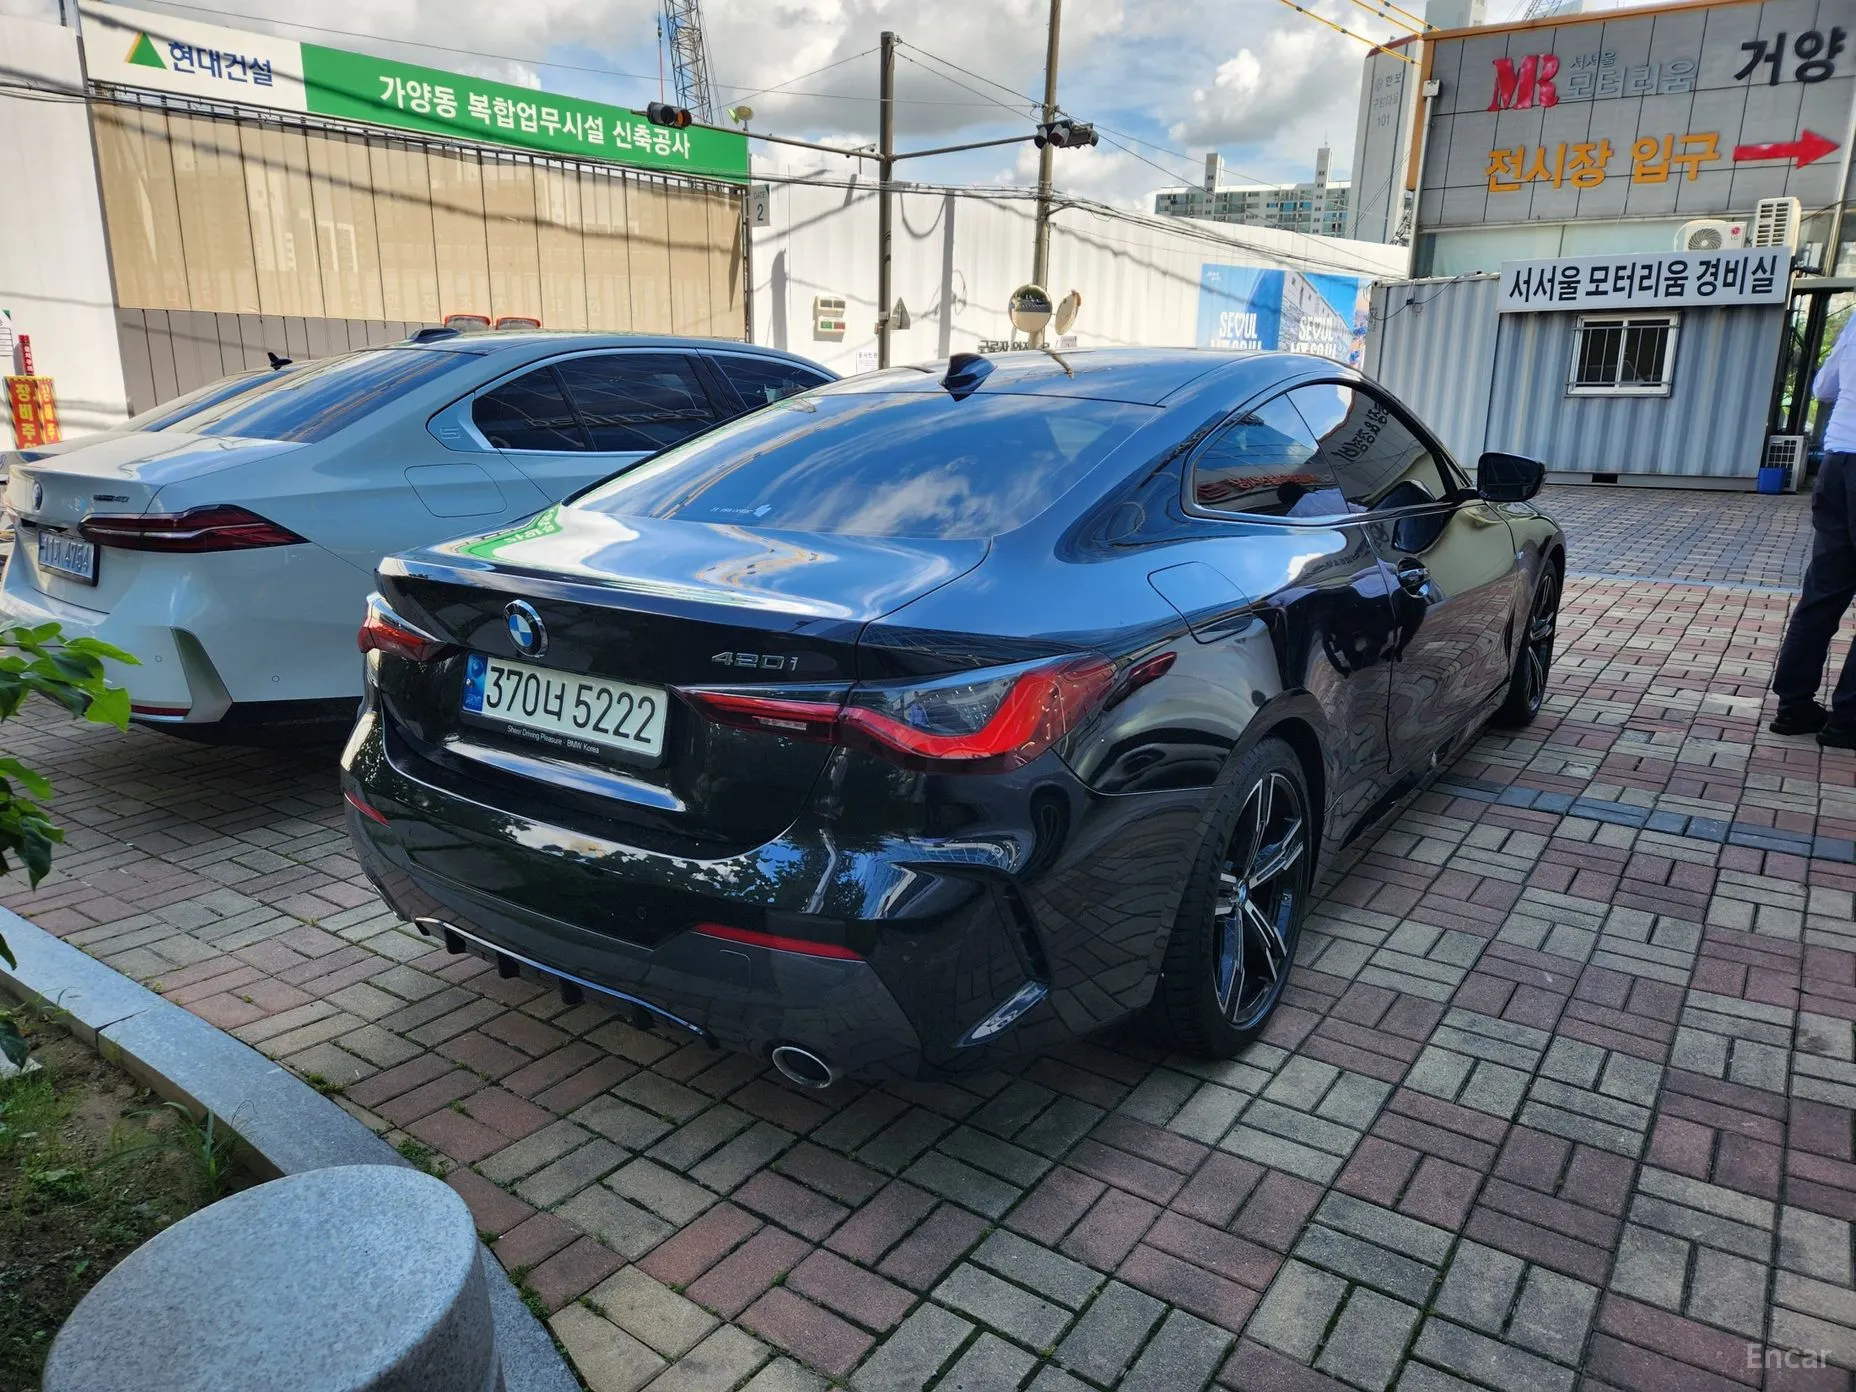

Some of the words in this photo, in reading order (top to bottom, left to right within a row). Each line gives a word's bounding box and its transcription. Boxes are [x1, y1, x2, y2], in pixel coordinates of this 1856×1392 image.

[168, 41, 273, 87] 현대건설
[1570, 50, 1616, 70] 서서울
[1734, 26, 1847, 85] 거양
[1487, 53, 1561, 112] MR
[1560, 58, 1697, 101] 모터리움
[379, 75, 458, 118] 가양동
[468, 91, 605, 145] 복합업무시설
[613, 120, 691, 159] 신축공사
[1378, 113, 1391, 127] 101
[1484, 139, 1614, 193] 전시장
[1631, 131, 1721, 185] 입구
[756, 203, 764, 221] 2
[1509, 266, 1581, 303] 서서울
[1585, 260, 1689, 299] 모터리움
[1696, 255, 1777, 297] 경비실
[711, 651, 799, 671] 420i
[486, 666, 566, 722] 370너
[572, 683, 656, 744] 5222
[507, 724, 522, 734] Sheer
[522, 728, 540, 742] Driving
[540, 733, 563, 746] Pleasure
[566, 739, 582, 750] BMW
[583, 743, 600, 754] Korea
